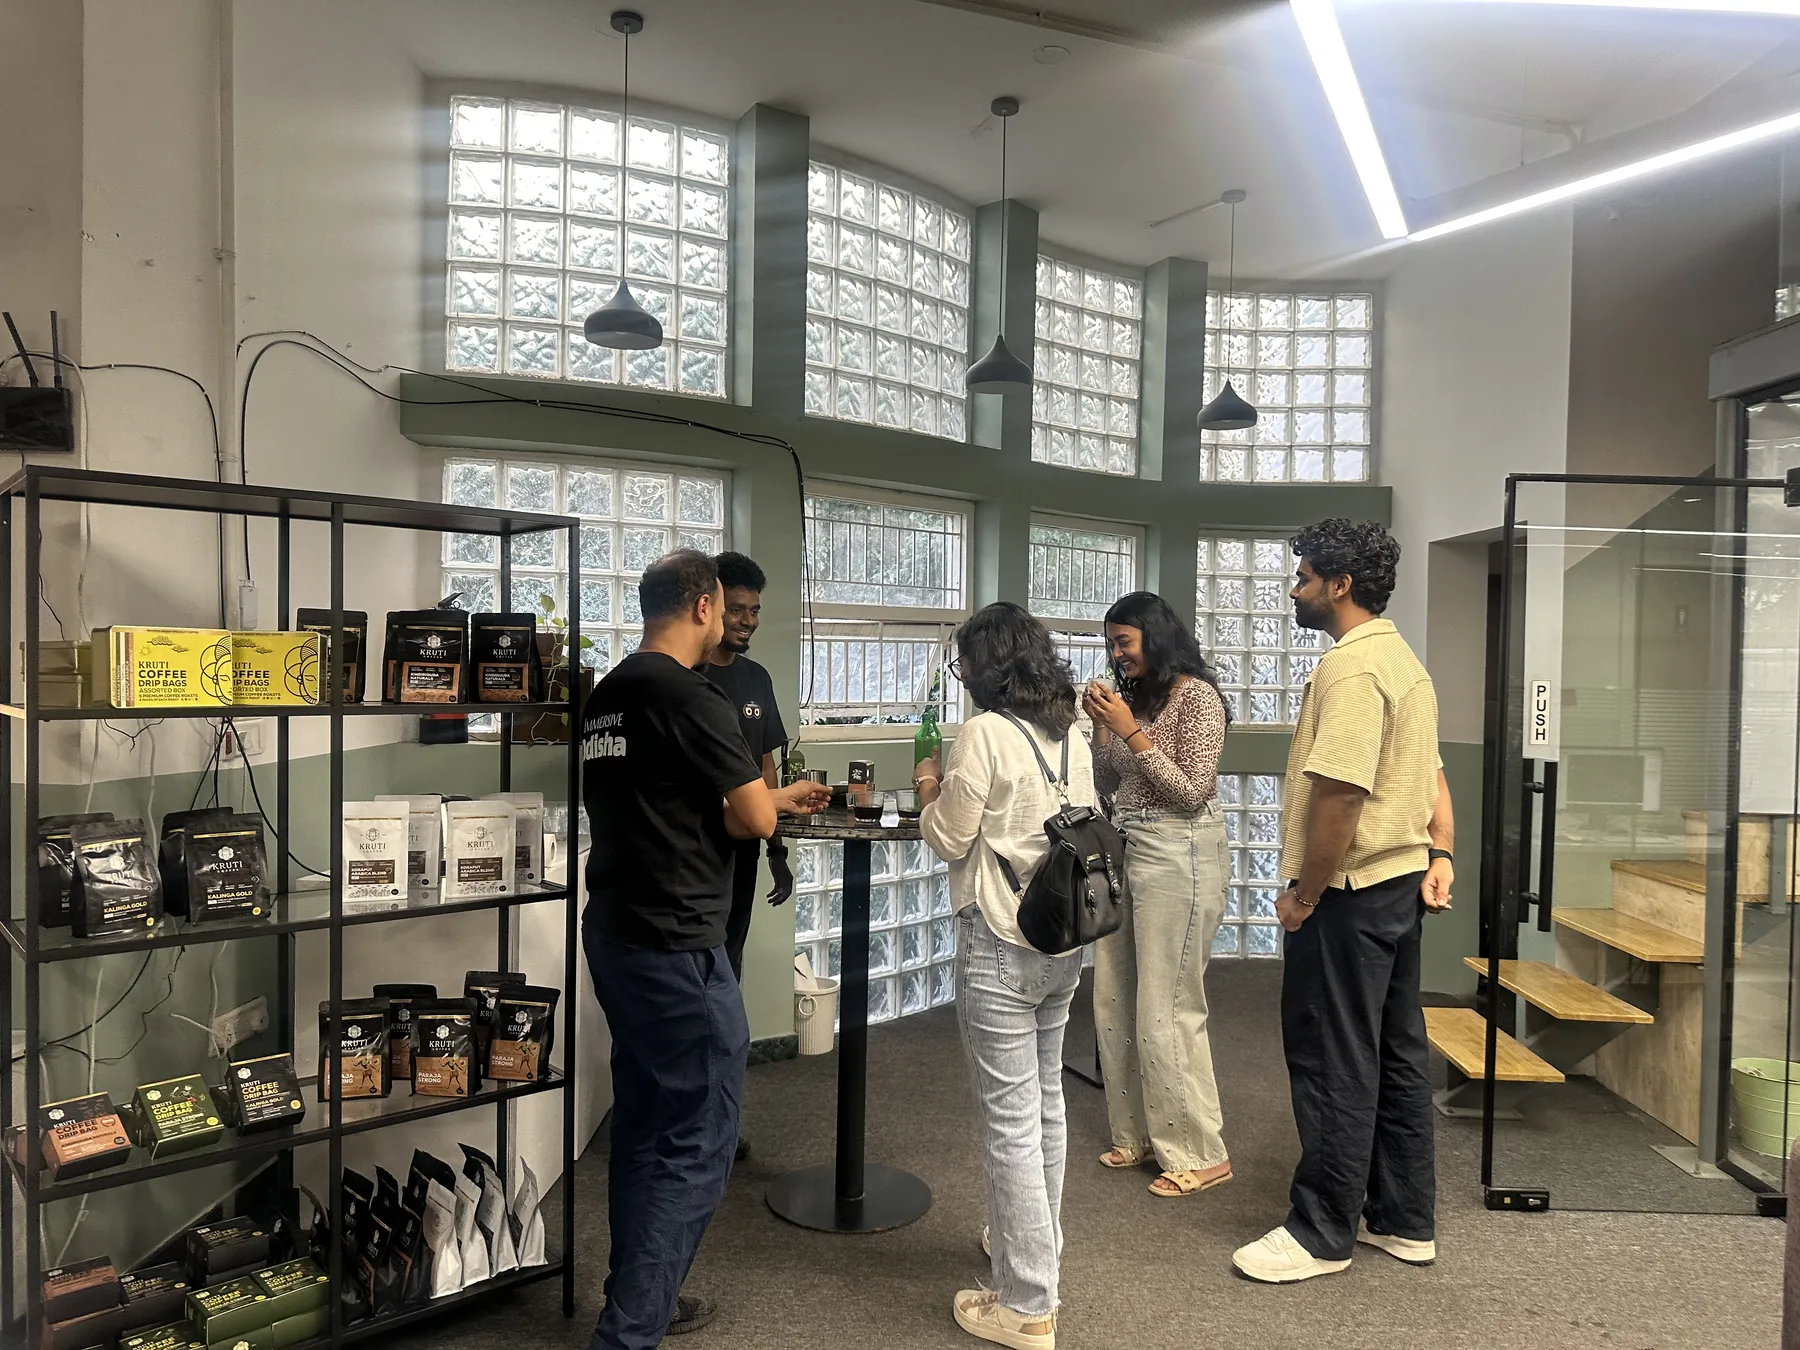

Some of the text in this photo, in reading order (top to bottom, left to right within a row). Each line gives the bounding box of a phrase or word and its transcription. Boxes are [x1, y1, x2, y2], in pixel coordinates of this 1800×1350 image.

[138, 670, 187, 678] COFFEE
[1535, 685, 1546, 740] PUSH
[584, 713, 624, 733] IMMERSIVE
[212, 861, 242, 870] KRUTI
[104, 904, 131, 913] KALINGA
[240, 1080, 260, 1088] KRUTI
[242, 1082, 279, 1094] COFFEE
[243, 1092, 262, 1100] DRIP
[151, 1101, 172, 1109] KRUTI
[153, 1101, 193, 1114] COFFEE
[155, 1112, 175, 1120] DRIP
[53, 1120, 76, 1128] KRUTI
[56, 1120, 98, 1134] COFFEE
[58, 1126, 98, 1140] DRIP BAG
